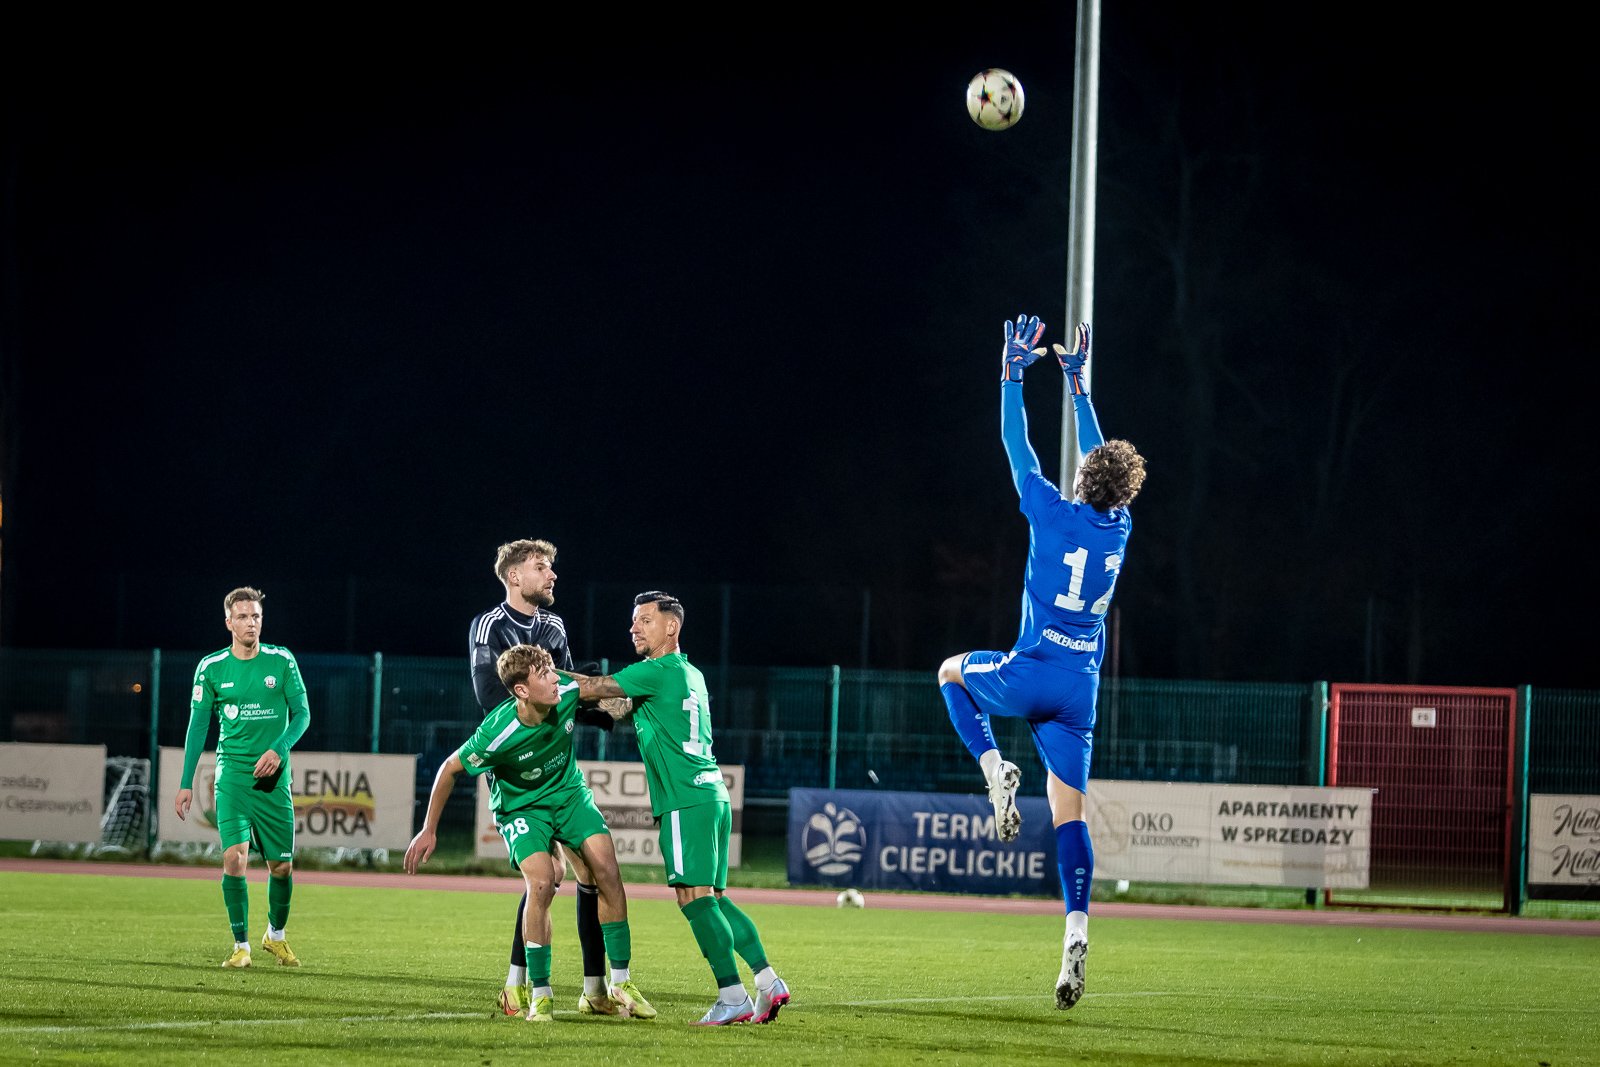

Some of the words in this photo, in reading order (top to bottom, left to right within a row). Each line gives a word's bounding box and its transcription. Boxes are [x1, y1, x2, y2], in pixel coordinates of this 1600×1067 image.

[1054, 547, 1121, 614] 12
[682, 690, 712, 757] 1
[518, 752, 533, 761] JAKO
[291, 767, 373, 799] LENIA
[1132, 811, 1173, 832] OKO
[1218, 799, 1359, 820] APARTAMENTY
[504, 817, 530, 841] 28
[912, 811, 996, 841] TERM
[1221, 826, 1238, 842] W
[1243, 826, 1354, 846] SPRZEDAŻY
[615, 838, 637, 855] 04
[879, 845, 1046, 880] CIEPLICKIE
